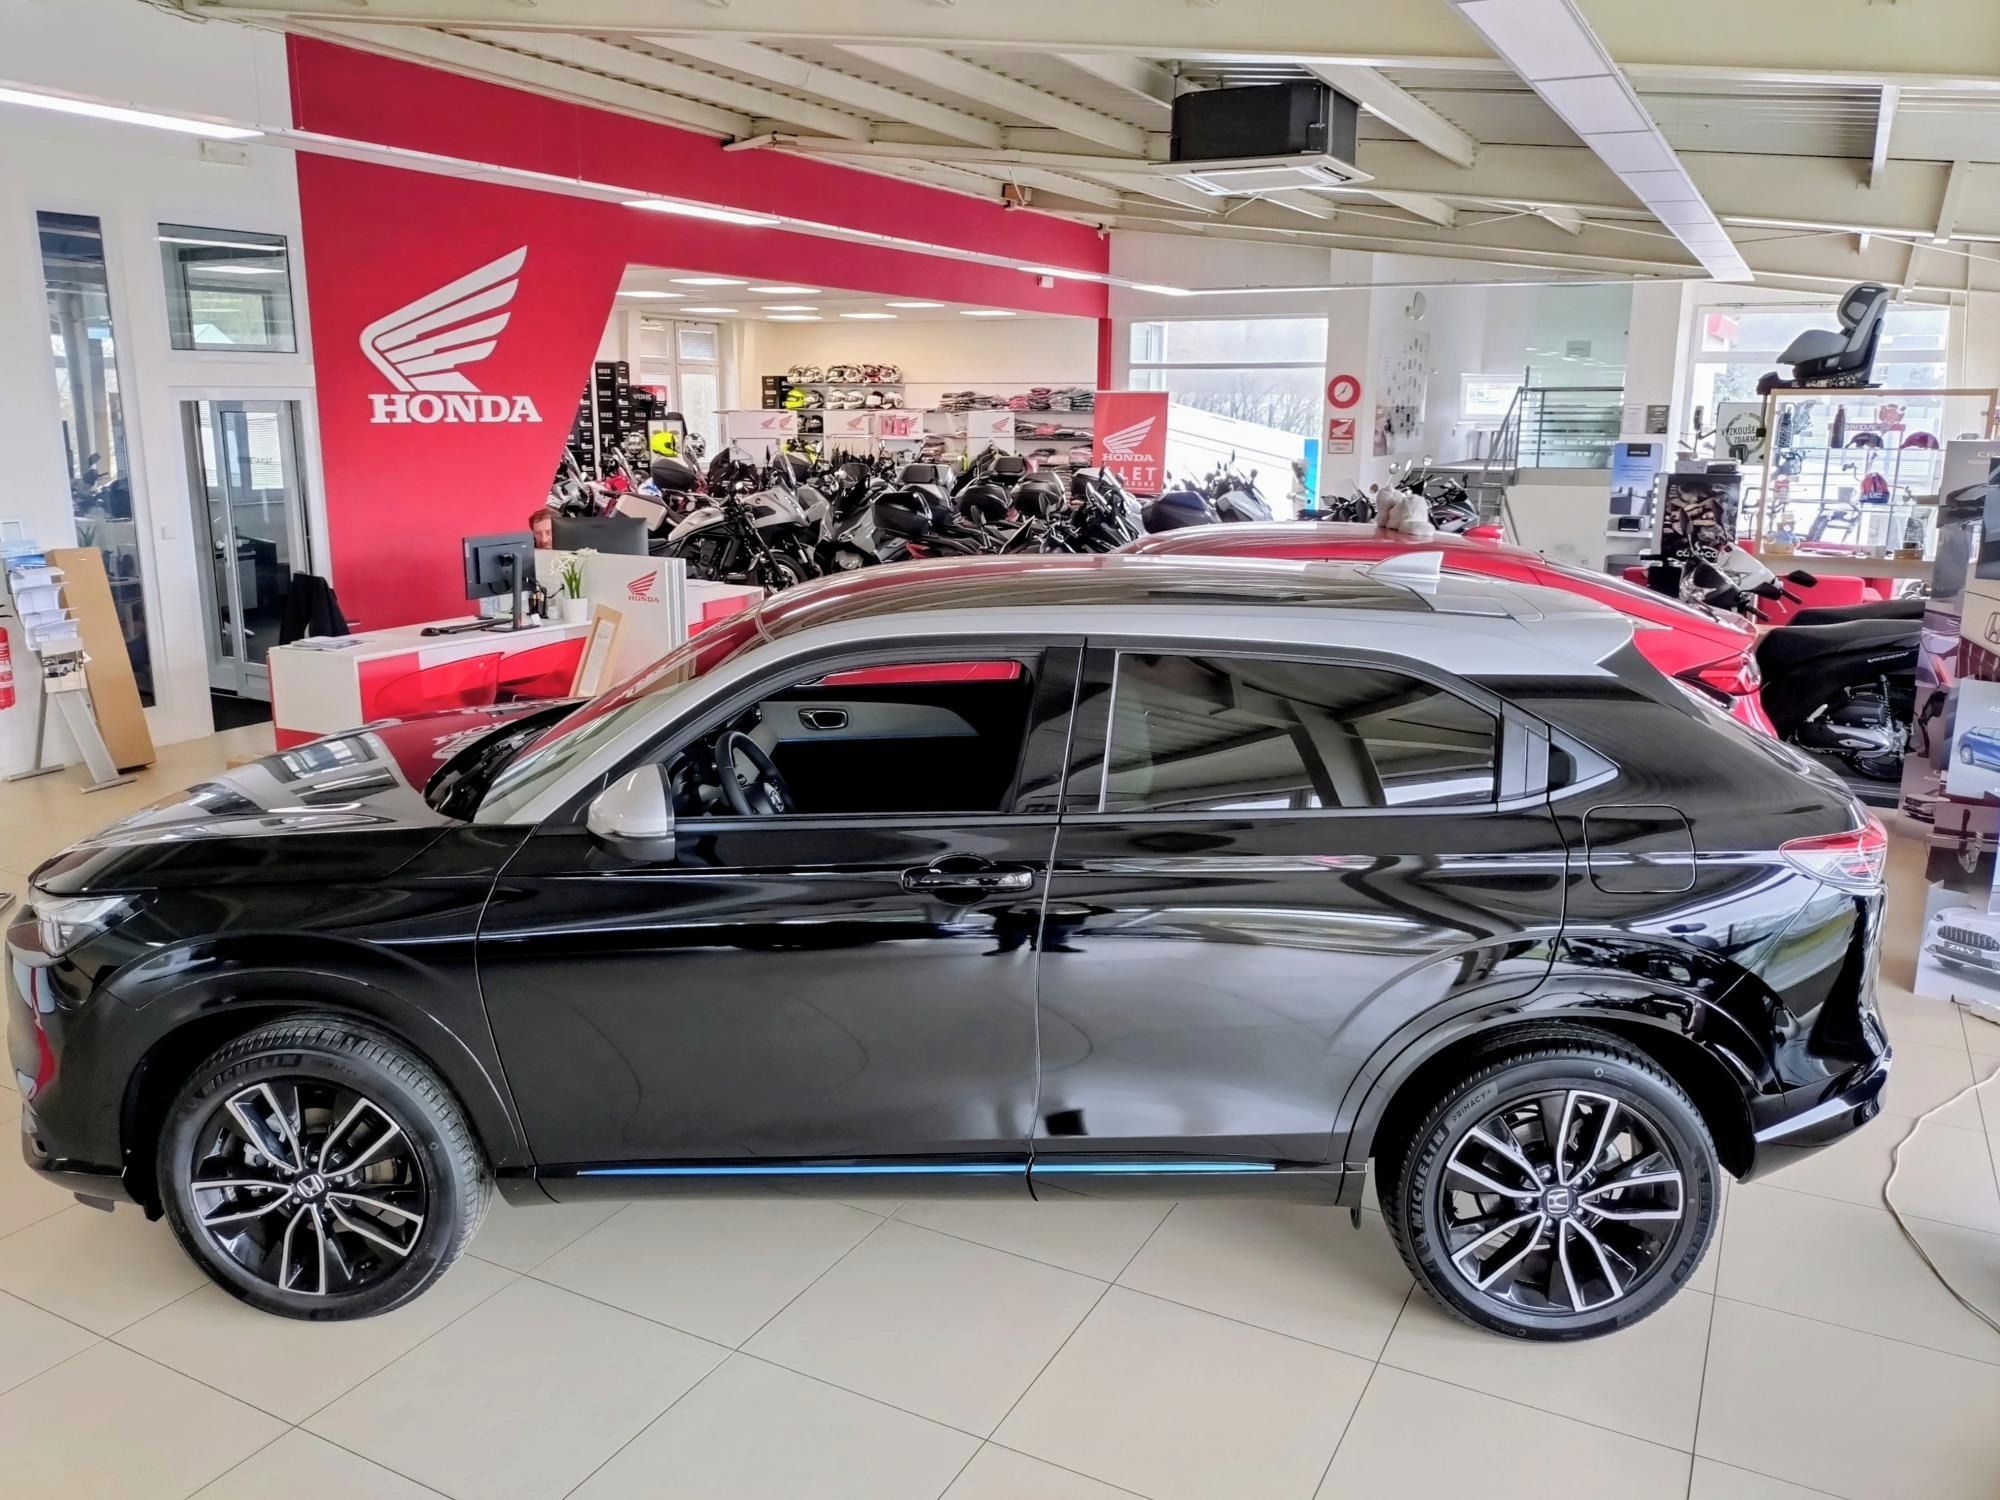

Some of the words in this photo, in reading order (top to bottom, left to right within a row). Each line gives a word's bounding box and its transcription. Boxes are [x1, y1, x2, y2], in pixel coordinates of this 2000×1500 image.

[368, 394, 543, 423] HONDA
[1721, 424, 1757, 436] VYZKOUŠE
[1102, 453, 1155, 462] HONDA
[628, 595, 660, 603] HONDA
[1451, 1092, 1487, 1122] PRIMACY
[1411, 1128, 1446, 1229] MICHELIN
